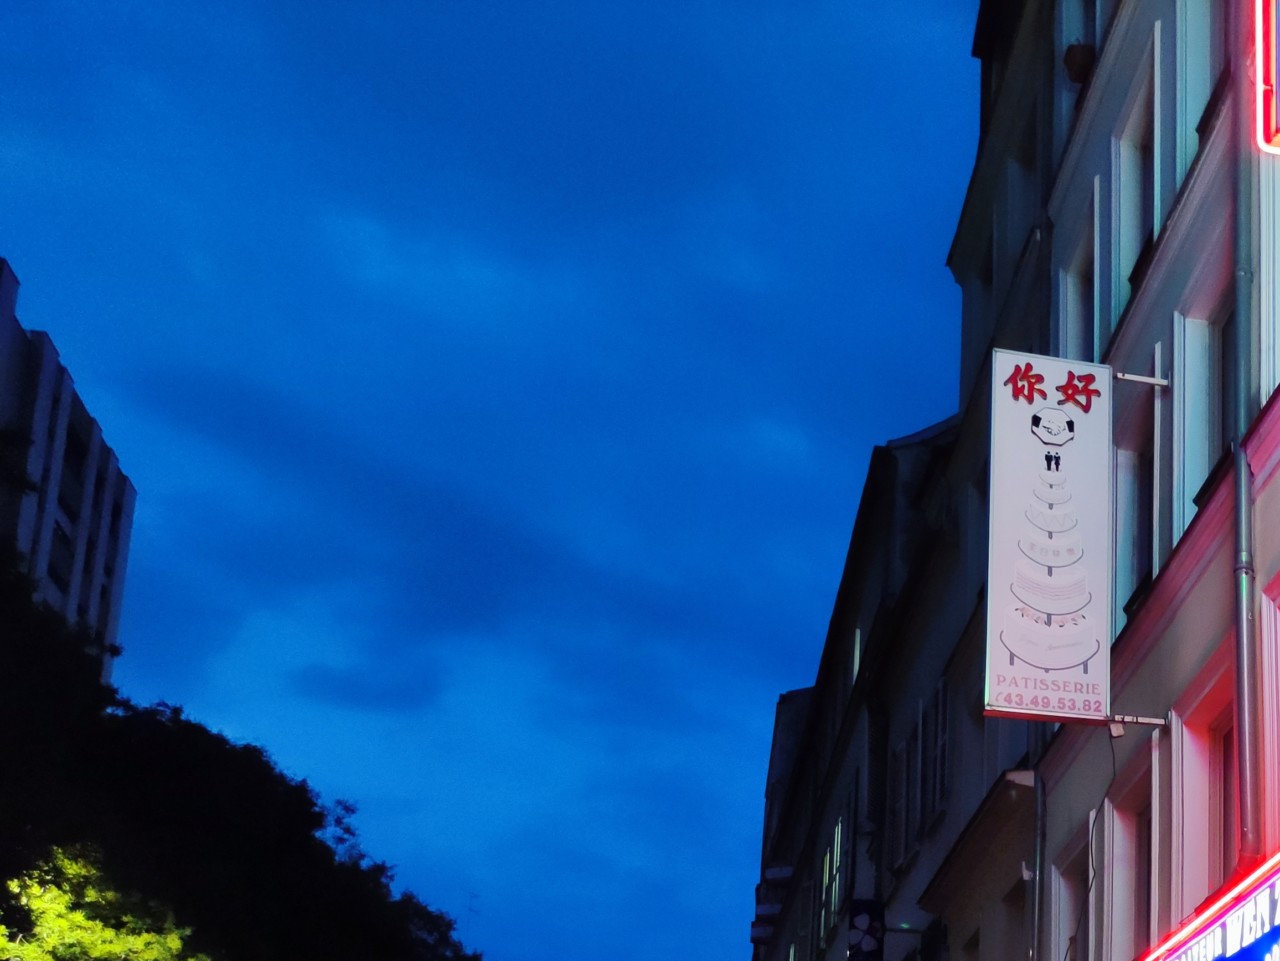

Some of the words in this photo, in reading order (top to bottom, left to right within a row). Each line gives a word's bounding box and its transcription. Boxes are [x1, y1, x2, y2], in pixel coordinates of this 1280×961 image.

[1004, 362, 1101, 413] 你好
[996, 674, 1101, 695] PATISSERIE
[1225, 888, 1271, 957] WEN
